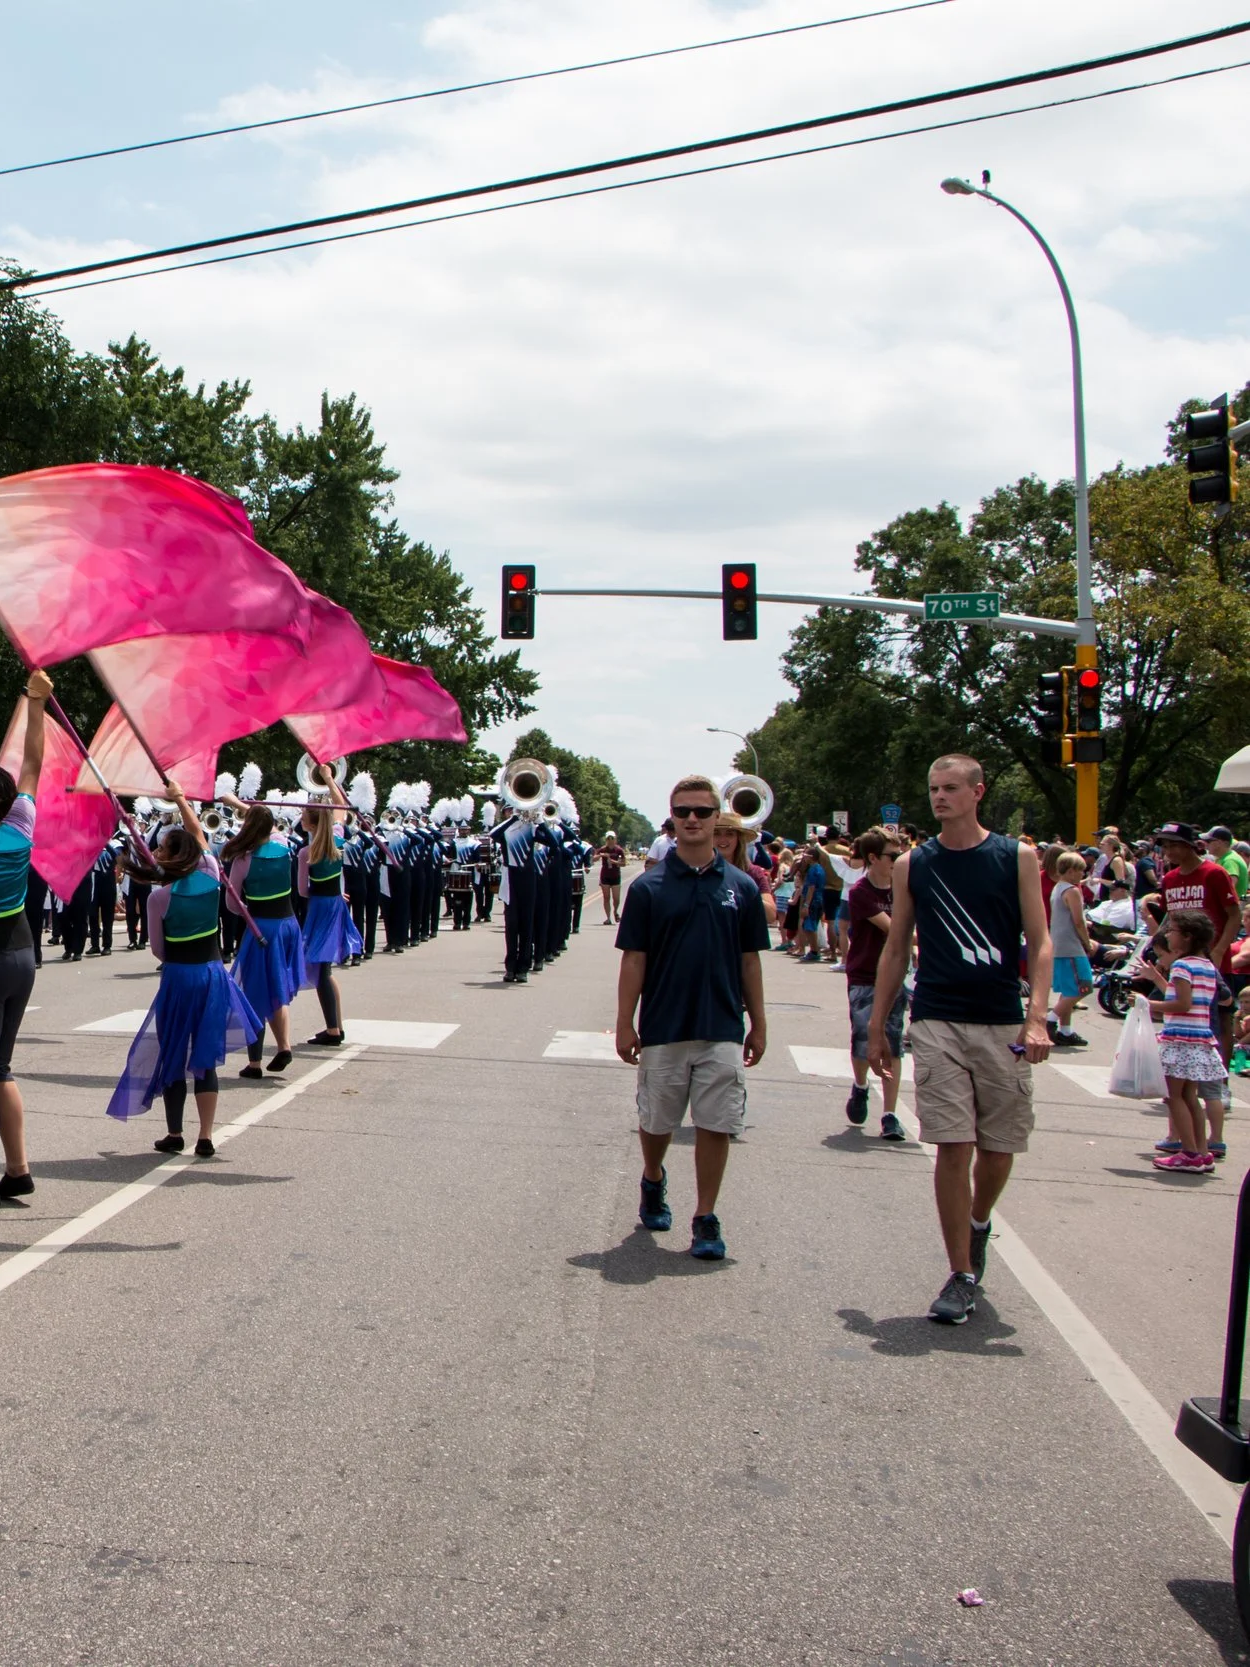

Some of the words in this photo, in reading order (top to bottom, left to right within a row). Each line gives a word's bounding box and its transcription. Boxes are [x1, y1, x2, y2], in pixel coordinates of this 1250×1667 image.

[928, 600, 969, 614] 70TH
[976, 599, 996, 612] St
[885, 810, 898, 819] 52
